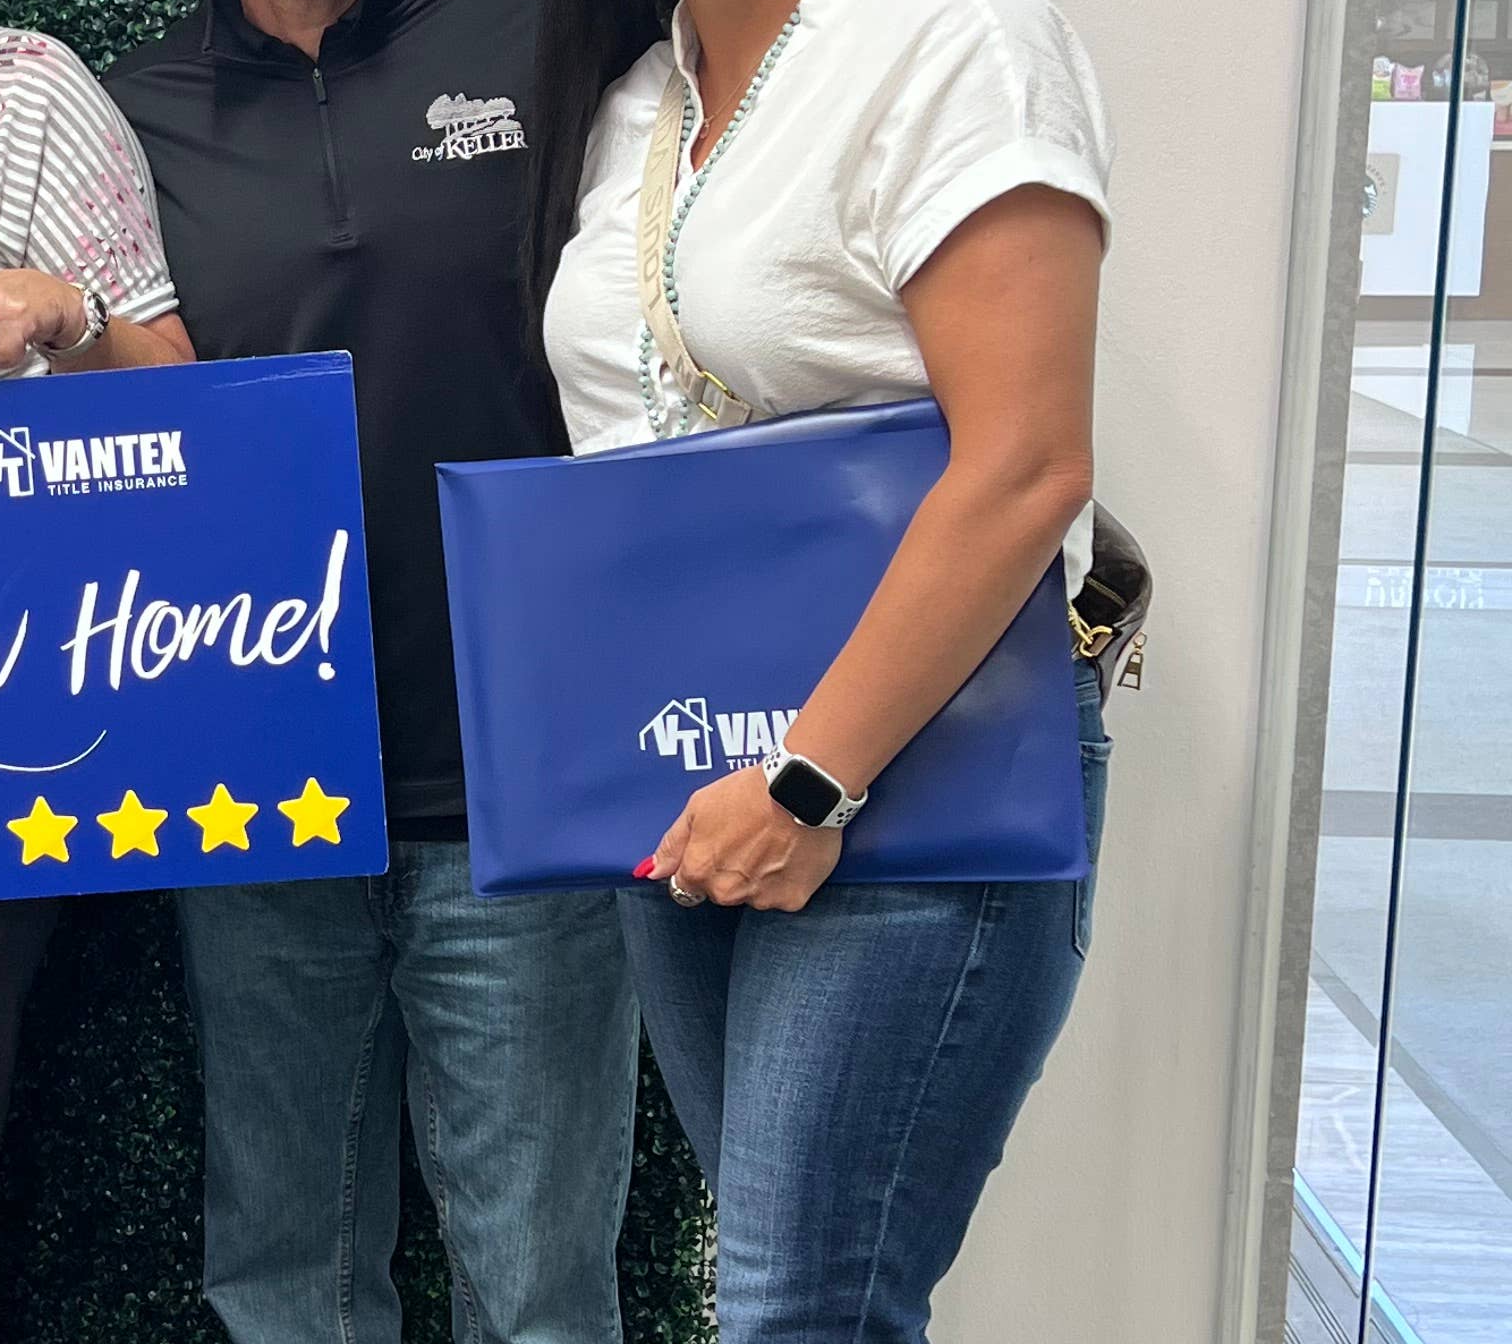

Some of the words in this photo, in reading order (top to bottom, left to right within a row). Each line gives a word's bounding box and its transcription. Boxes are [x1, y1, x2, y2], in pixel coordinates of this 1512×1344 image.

[446, 130, 529, 160] KELLER
[38, 430, 187, 483] VANTEX
[47, 481, 90, 496] TITLE
[98, 474, 188, 493] INSURANCE
[60, 529, 348, 696] Home!
[714, 707, 803, 757] VAN
